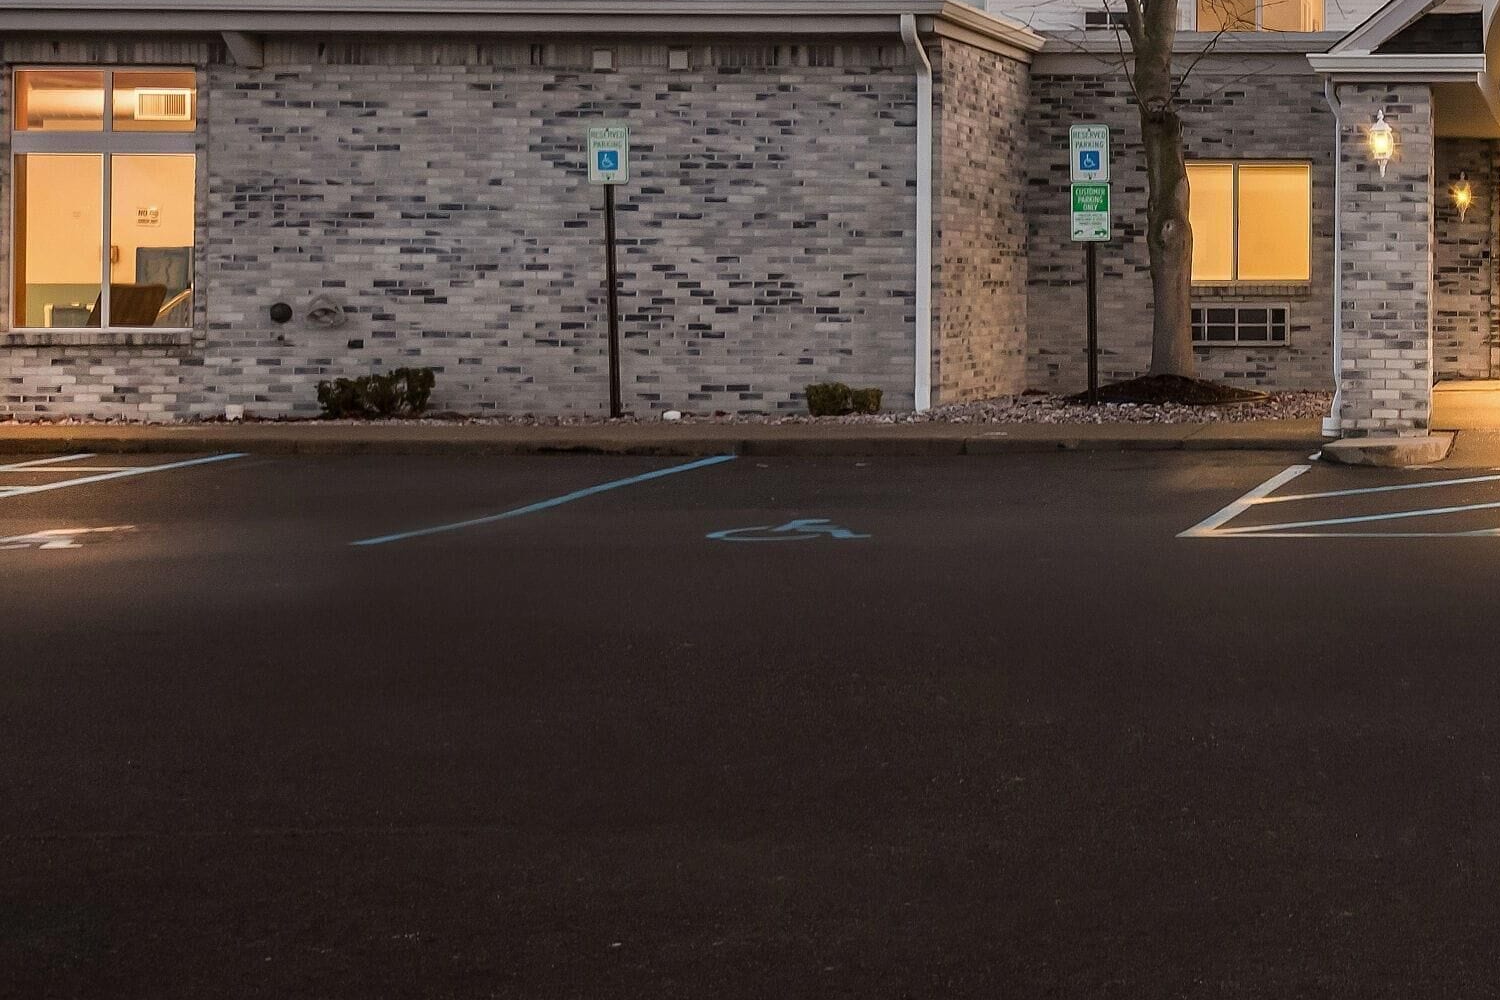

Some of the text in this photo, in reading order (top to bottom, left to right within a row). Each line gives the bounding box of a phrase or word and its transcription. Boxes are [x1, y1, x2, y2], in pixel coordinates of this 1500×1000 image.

[1073, 131, 1106, 139] RESERVED
[1075, 187, 1106, 196] CUSTOMER
[1082, 203, 1098, 211] ONLY
